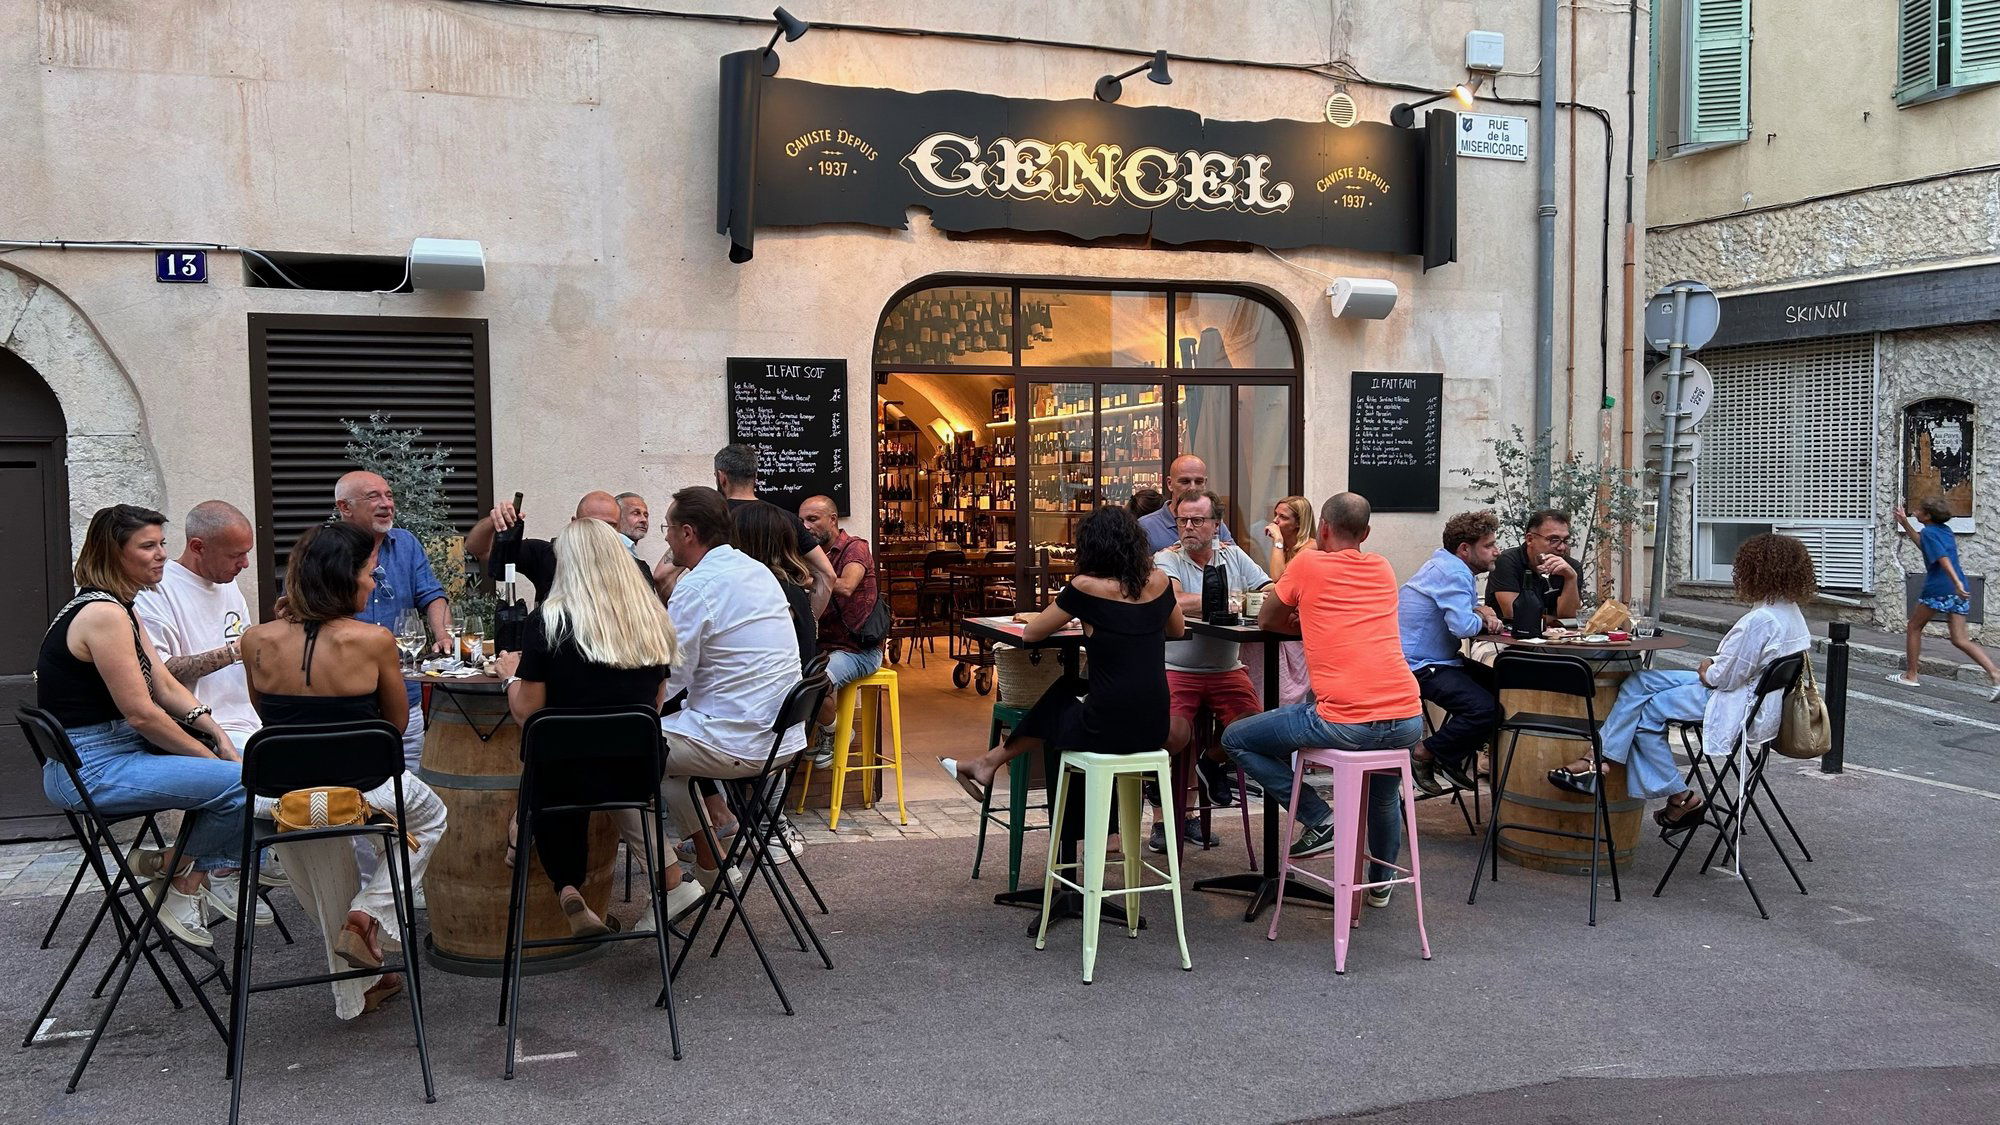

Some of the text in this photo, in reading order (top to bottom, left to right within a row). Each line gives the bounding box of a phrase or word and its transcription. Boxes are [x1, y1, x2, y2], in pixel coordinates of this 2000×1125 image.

[1488, 120, 1509, 130] RUE
[1488, 131, 1510, 142] de la
[785, 129, 880, 162] CAVISTE DEPUIS
[1461, 140, 1524, 156] MISERICORDE
[818, 160, 848, 177] 1937
[899, 131, 1295, 215] GENCEL
[1316, 166, 1390, 194] CAVISTE DEPUIS
[1341, 194, 1366, 209] 1937
[166, 254, 197, 276] 13
[1786, 300, 1848, 324] SKINNI
[766, 364, 826, 379] IL FAIT SOIF
[1371, 378, 1416, 390] IL FAIT FAIM
